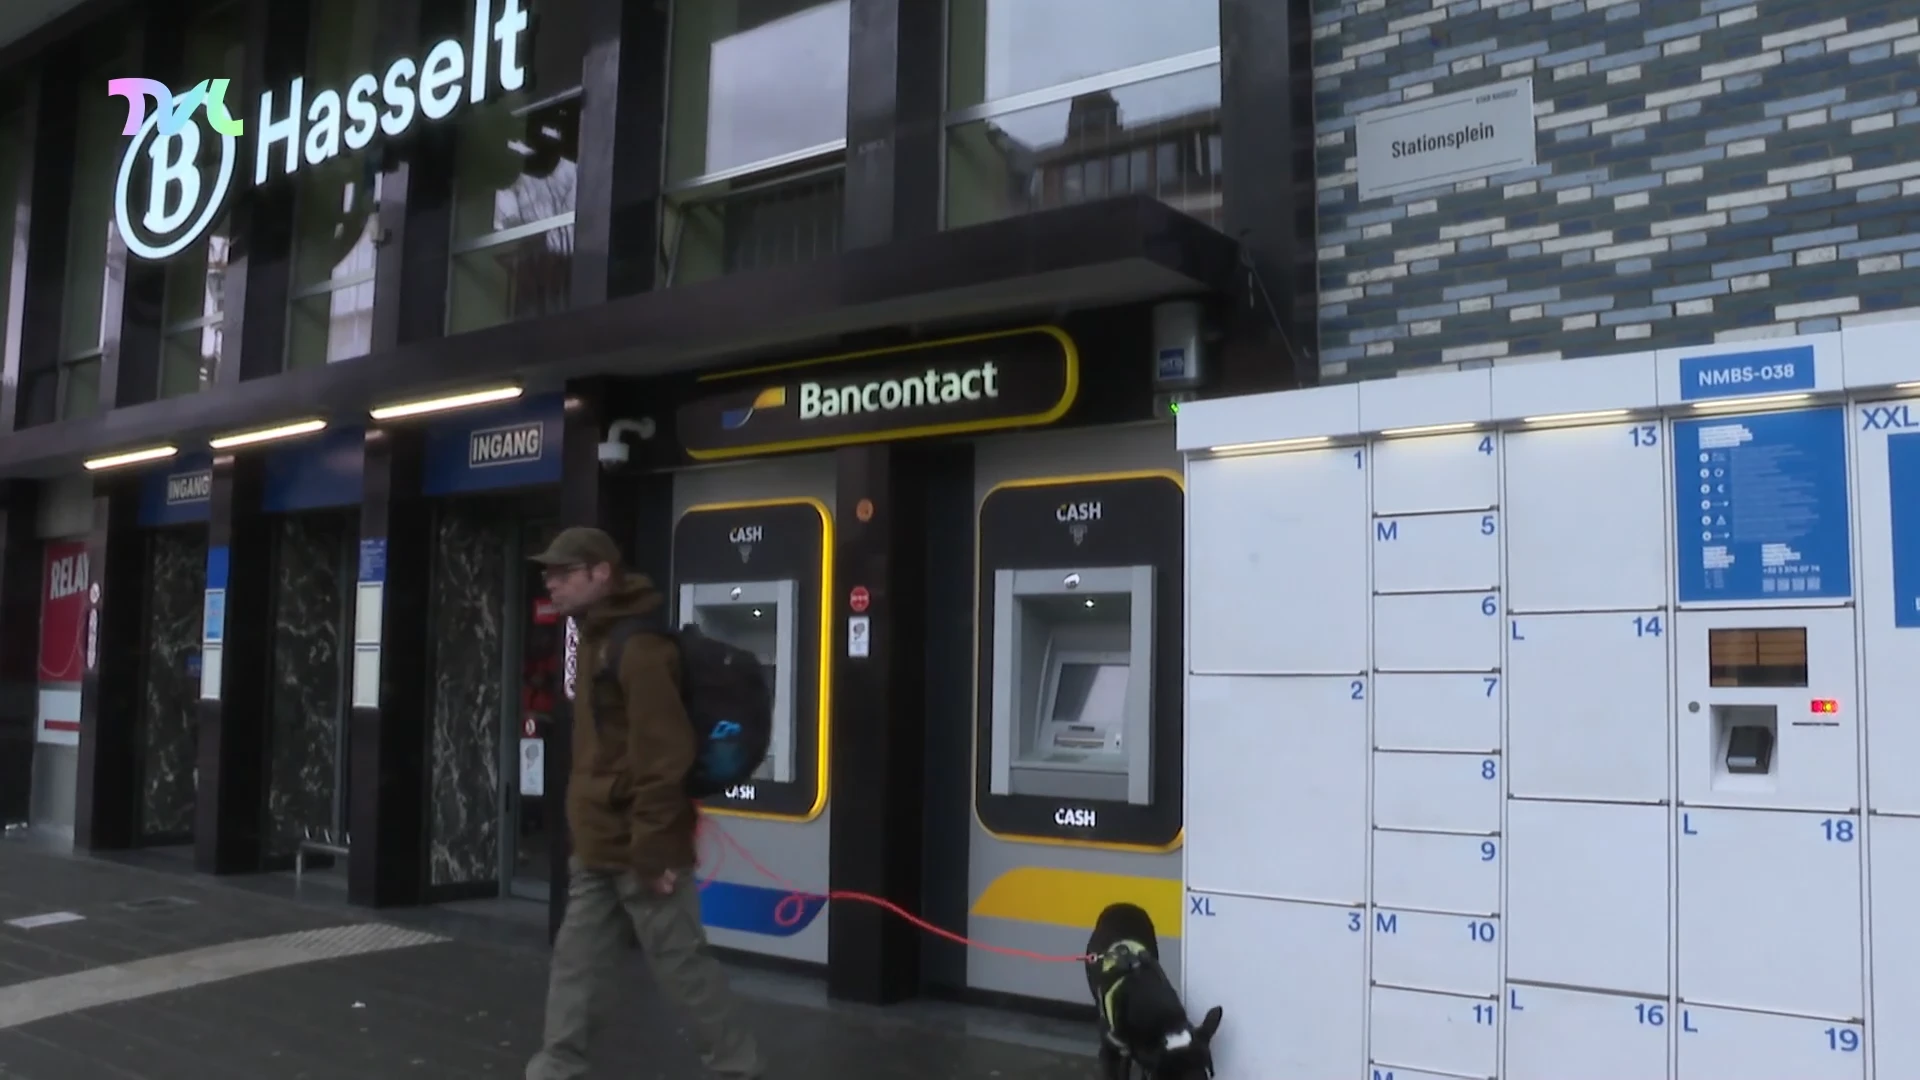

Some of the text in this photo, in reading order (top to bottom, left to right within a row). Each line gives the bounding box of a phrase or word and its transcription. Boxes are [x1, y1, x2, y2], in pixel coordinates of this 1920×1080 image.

[254, 0, 529, 186] Hasselt
[1391, 121, 1495, 159] Stationsplein
[1698, 363, 1795, 387] NMBS-038
[799, 361, 998, 420] Bancontact
[1861, 405, 1920, 431] XXL
[472, 428, 540, 462] INGANG
[1478, 435, 1495, 456] 4
[1629, 424, 1658, 447] 13
[1353, 449, 1362, 470] 1
[169, 475, 210, 499] INGANG
[1056, 501, 1102, 521] CASH
[729, 525, 763, 543] CASH
[1377, 520, 1398, 542] M
[1481, 515, 1495, 536] 5
[1481, 595, 1497, 616] 6
[1511, 620, 1525, 641] L
[1633, 616, 1663, 637] 14
[1351, 680, 1364, 700] 2
[1483, 677, 1498, 698] 7
[1481, 759, 1496, 780] 8
[724, 785, 756, 800] CASH
[1055, 808, 1096, 827] CASH
[1683, 813, 1698, 836] L
[1821, 818, 1854, 843] 18
[1480, 841, 1496, 861] 9
[1190, 896, 1216, 917] XL
[1348, 911, 1361, 932] 3
[1376, 912, 1397, 934] M
[1468, 921, 1495, 943] 10
[1510, 989, 1524, 1011] L
[1473, 1004, 1493, 1026] 11
[1635, 1003, 1664, 1026] 16
[1683, 1010, 1698, 1033] L
[1824, 1027, 1859, 1052] 19
